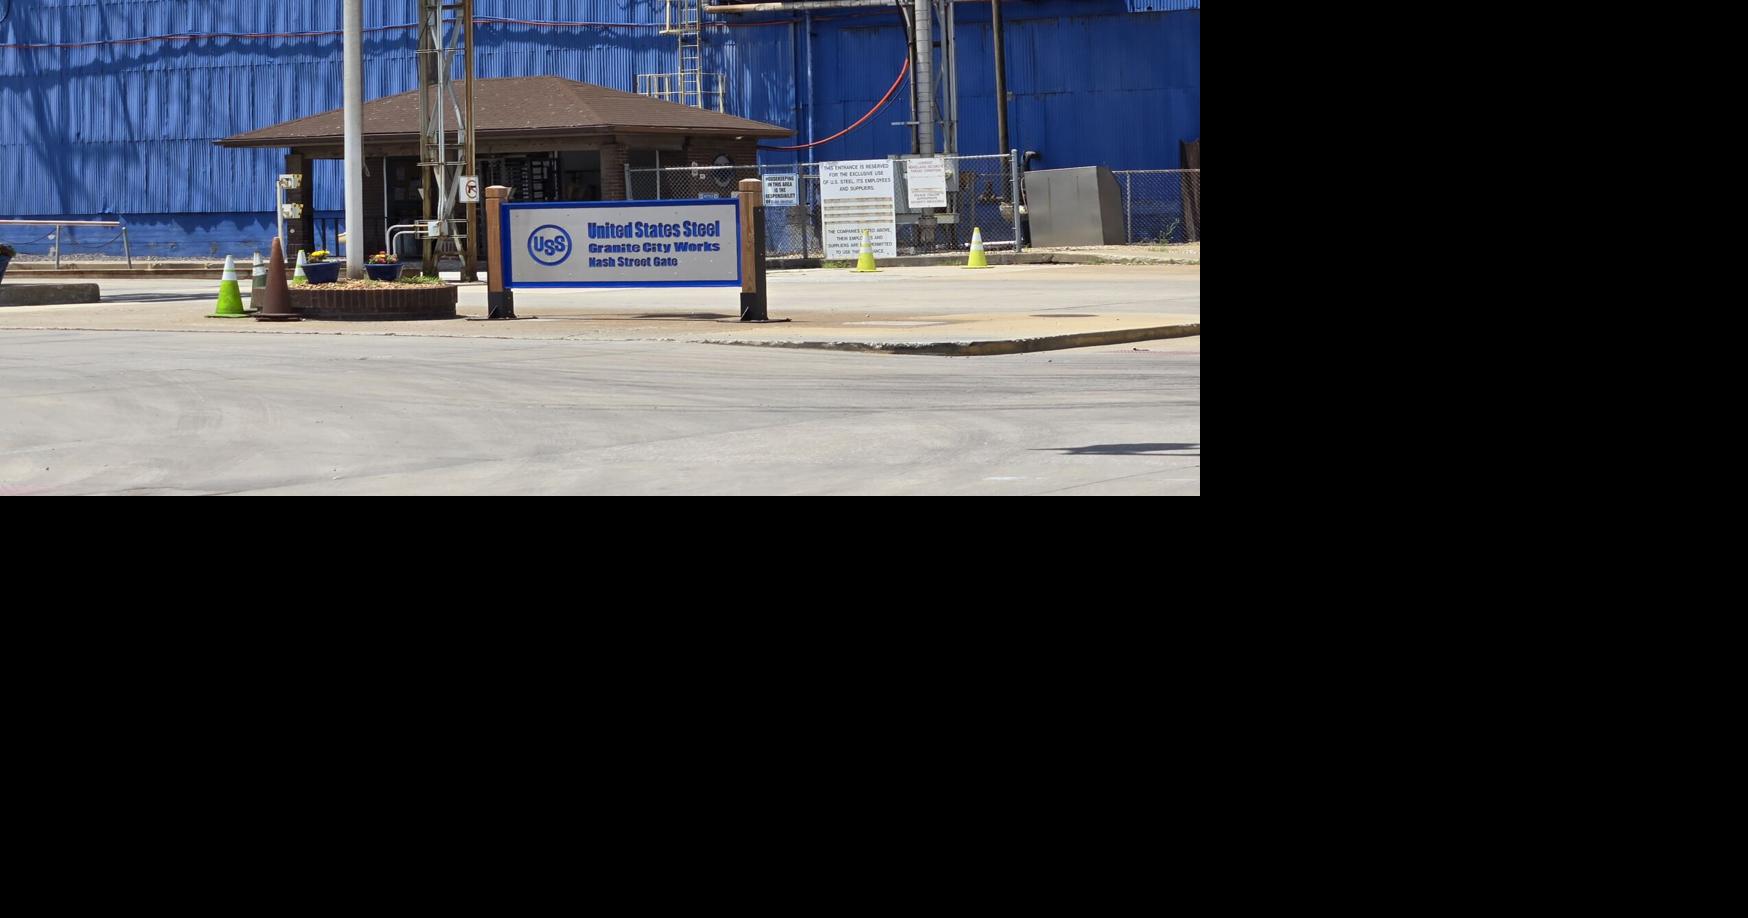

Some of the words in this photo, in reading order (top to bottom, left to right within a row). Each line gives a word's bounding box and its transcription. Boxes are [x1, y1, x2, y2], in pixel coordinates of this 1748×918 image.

[588, 222, 632, 239] United
[635, 221, 681, 238] States
[683, 220, 720, 237] Steel
[533, 235, 566, 256] USS
[588, 243, 640, 253] Granite
[643, 242, 671, 253] City
[674, 242, 720, 252] Works
[589, 257, 615, 268] Nash
[617, 256, 651, 267] Street
[653, 257, 678, 267] Gate
